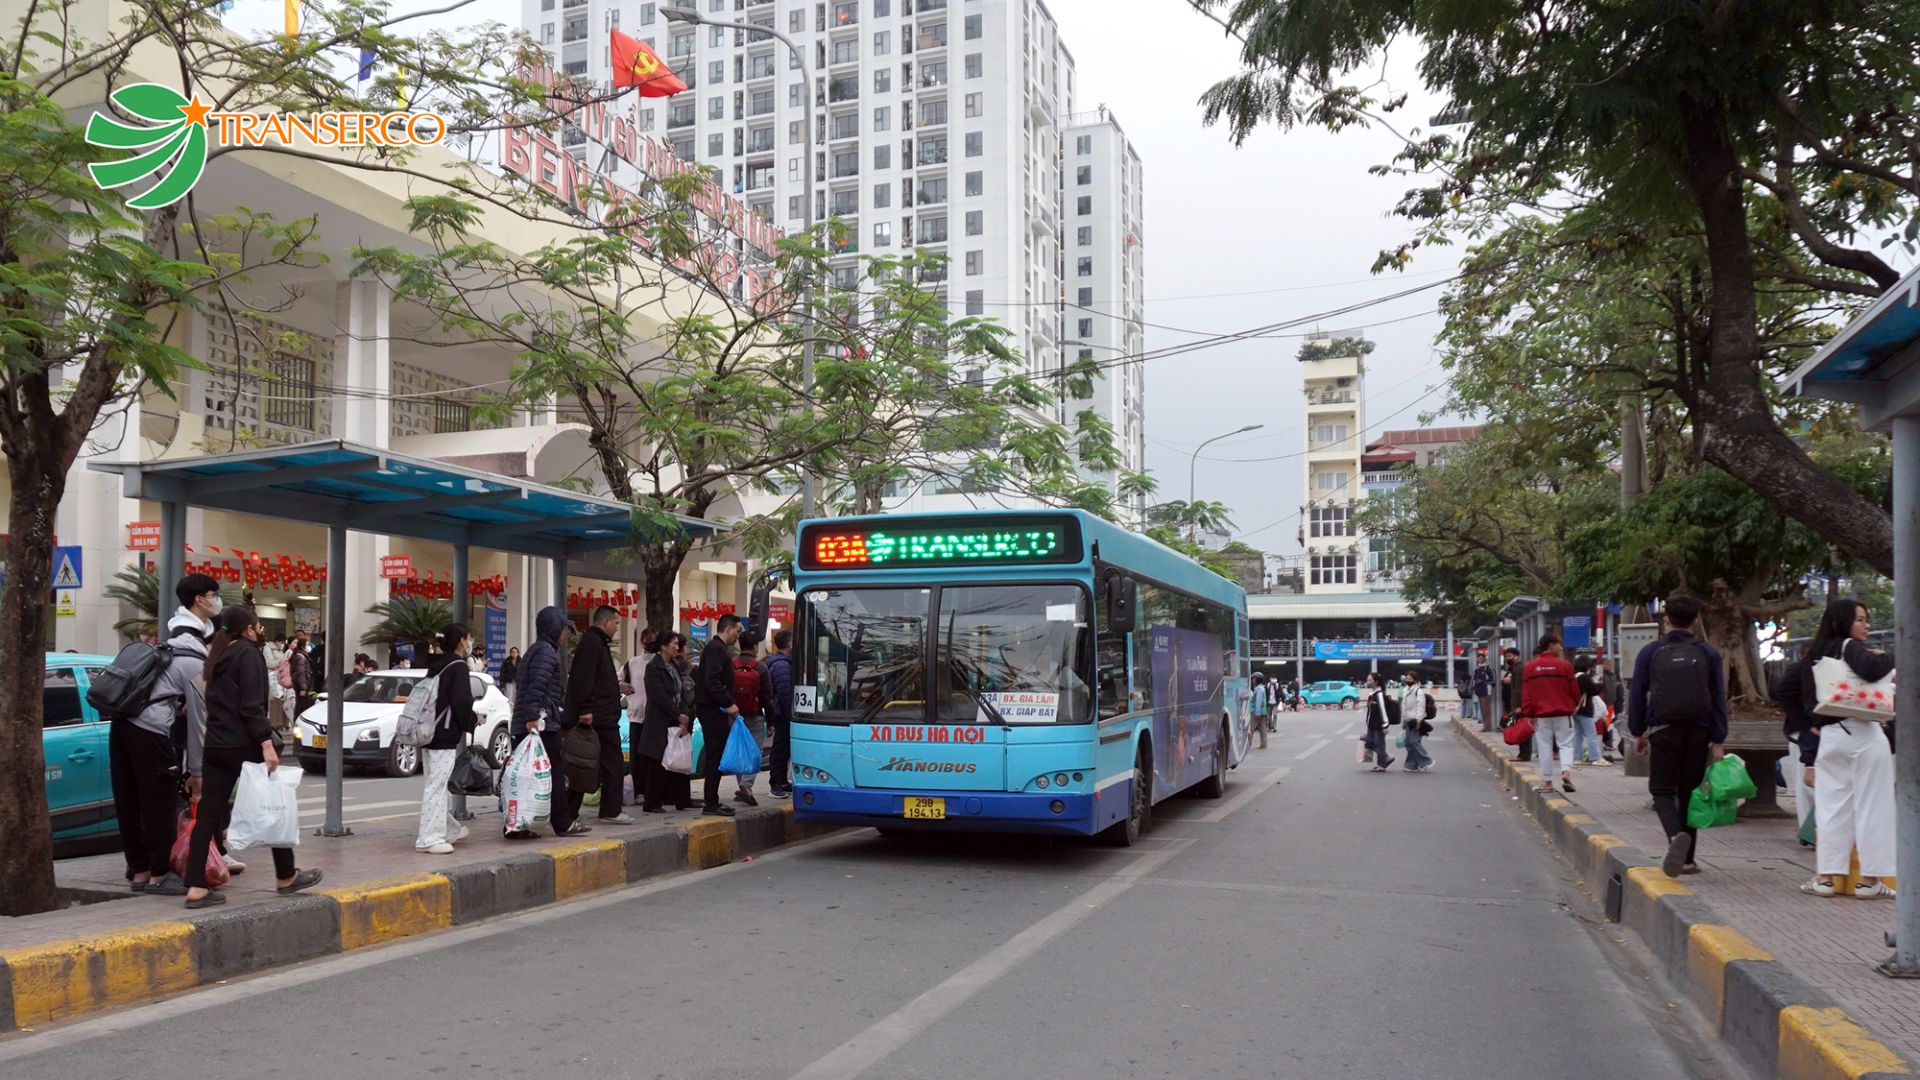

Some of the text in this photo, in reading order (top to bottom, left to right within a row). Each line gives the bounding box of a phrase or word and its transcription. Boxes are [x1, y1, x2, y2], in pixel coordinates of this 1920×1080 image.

[818, 534, 867, 563] 03A
[1003, 694, 1017, 703] BX.
[1020, 694, 1034, 703] GIA
[1000, 707, 1014, 716] BX.
[895, 726, 923, 741] BUS
[927, 725, 949, 742] HÀ
[915, 798, 933, 808] 29B
[909, 808, 941, 818] 194.13
